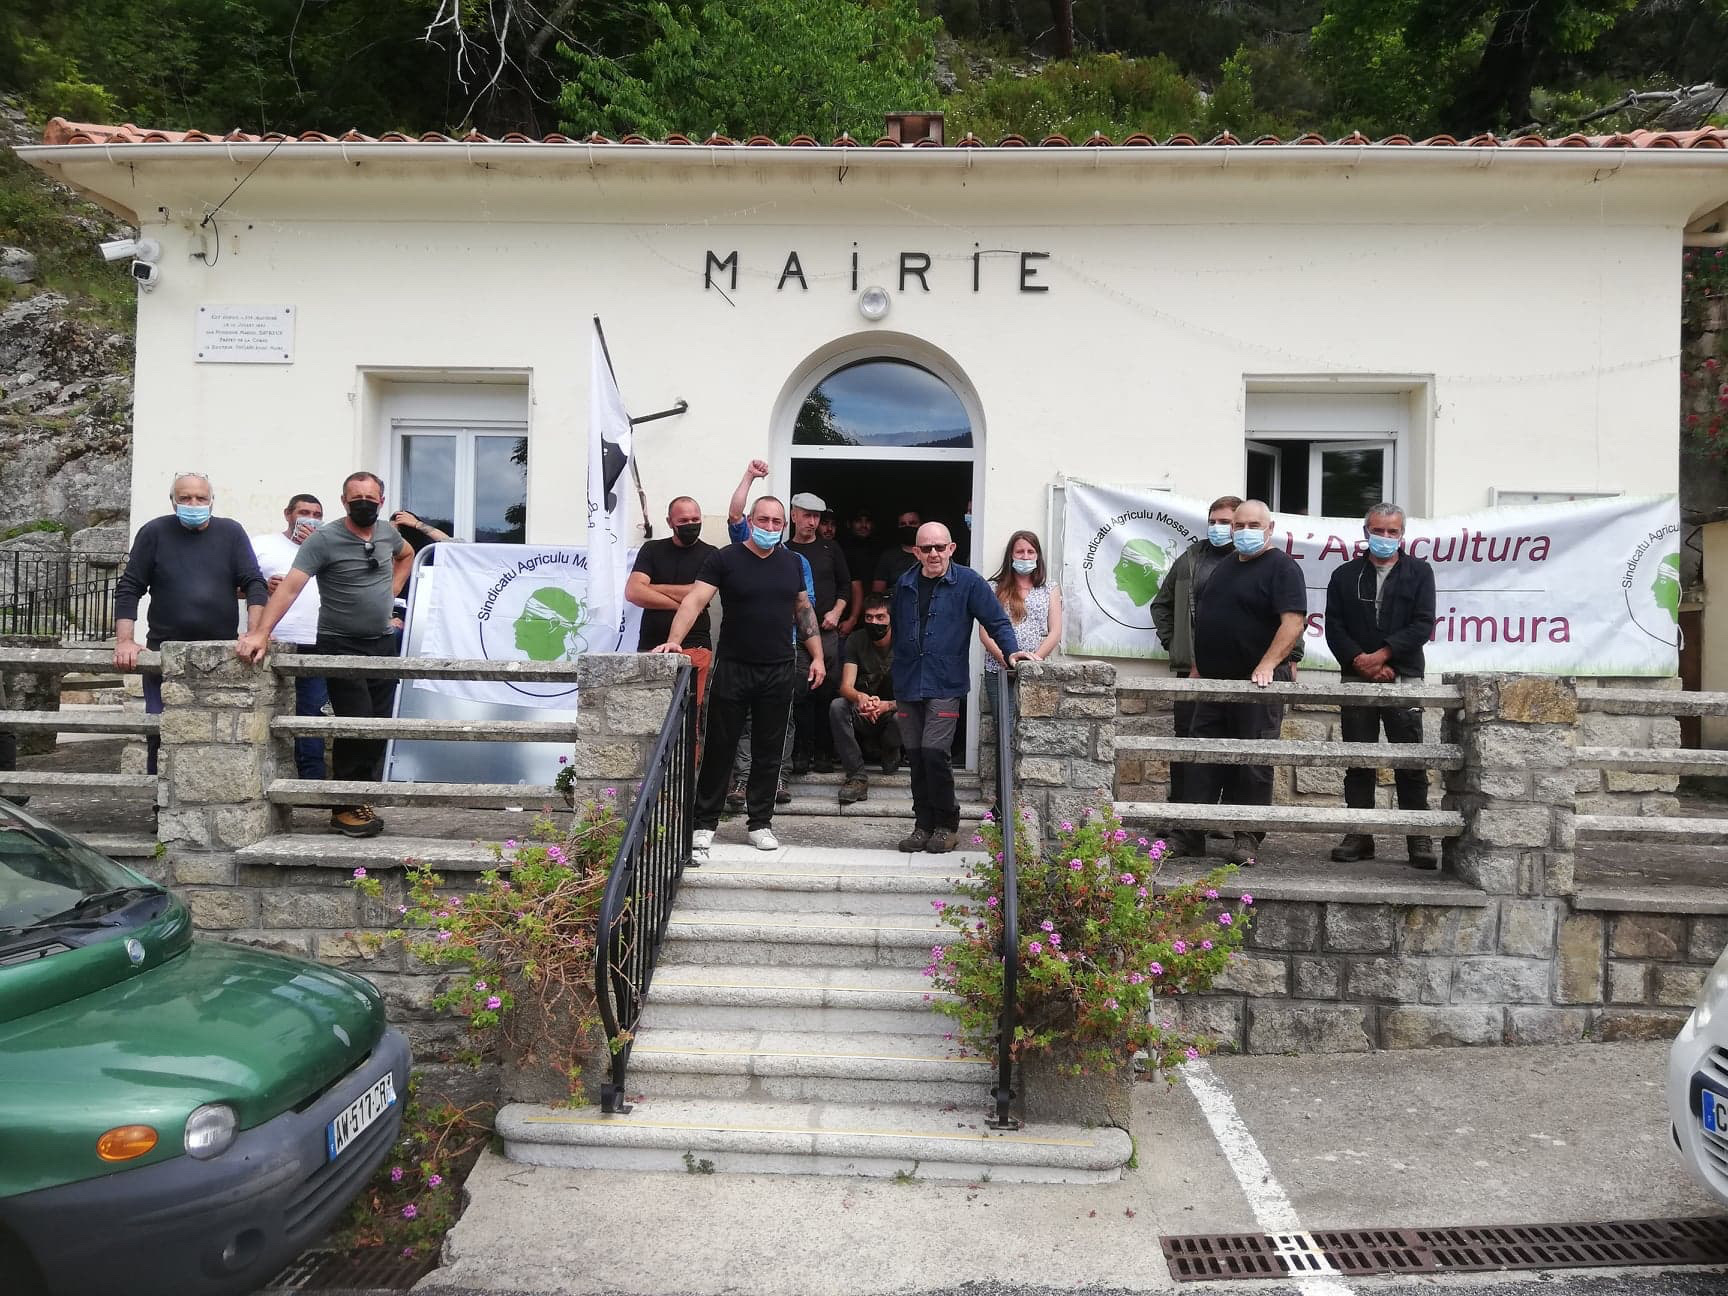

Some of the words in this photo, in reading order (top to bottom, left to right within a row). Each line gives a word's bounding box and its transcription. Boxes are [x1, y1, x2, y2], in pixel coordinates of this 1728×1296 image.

[1083, 523, 1112, 570] Sindicatu
[1111, 509, 1154, 526] Agriculu
[1156, 511, 1190, 538] Mossa
[1285, 527, 1551, 563] L'Agcultura
[477, 568, 517, 621] Sindicatu
[517, 552, 569, 574] Agriculu
[1622, 540, 1650, 589] Sindicatu
[1428, 607, 1570, 643] rimura
